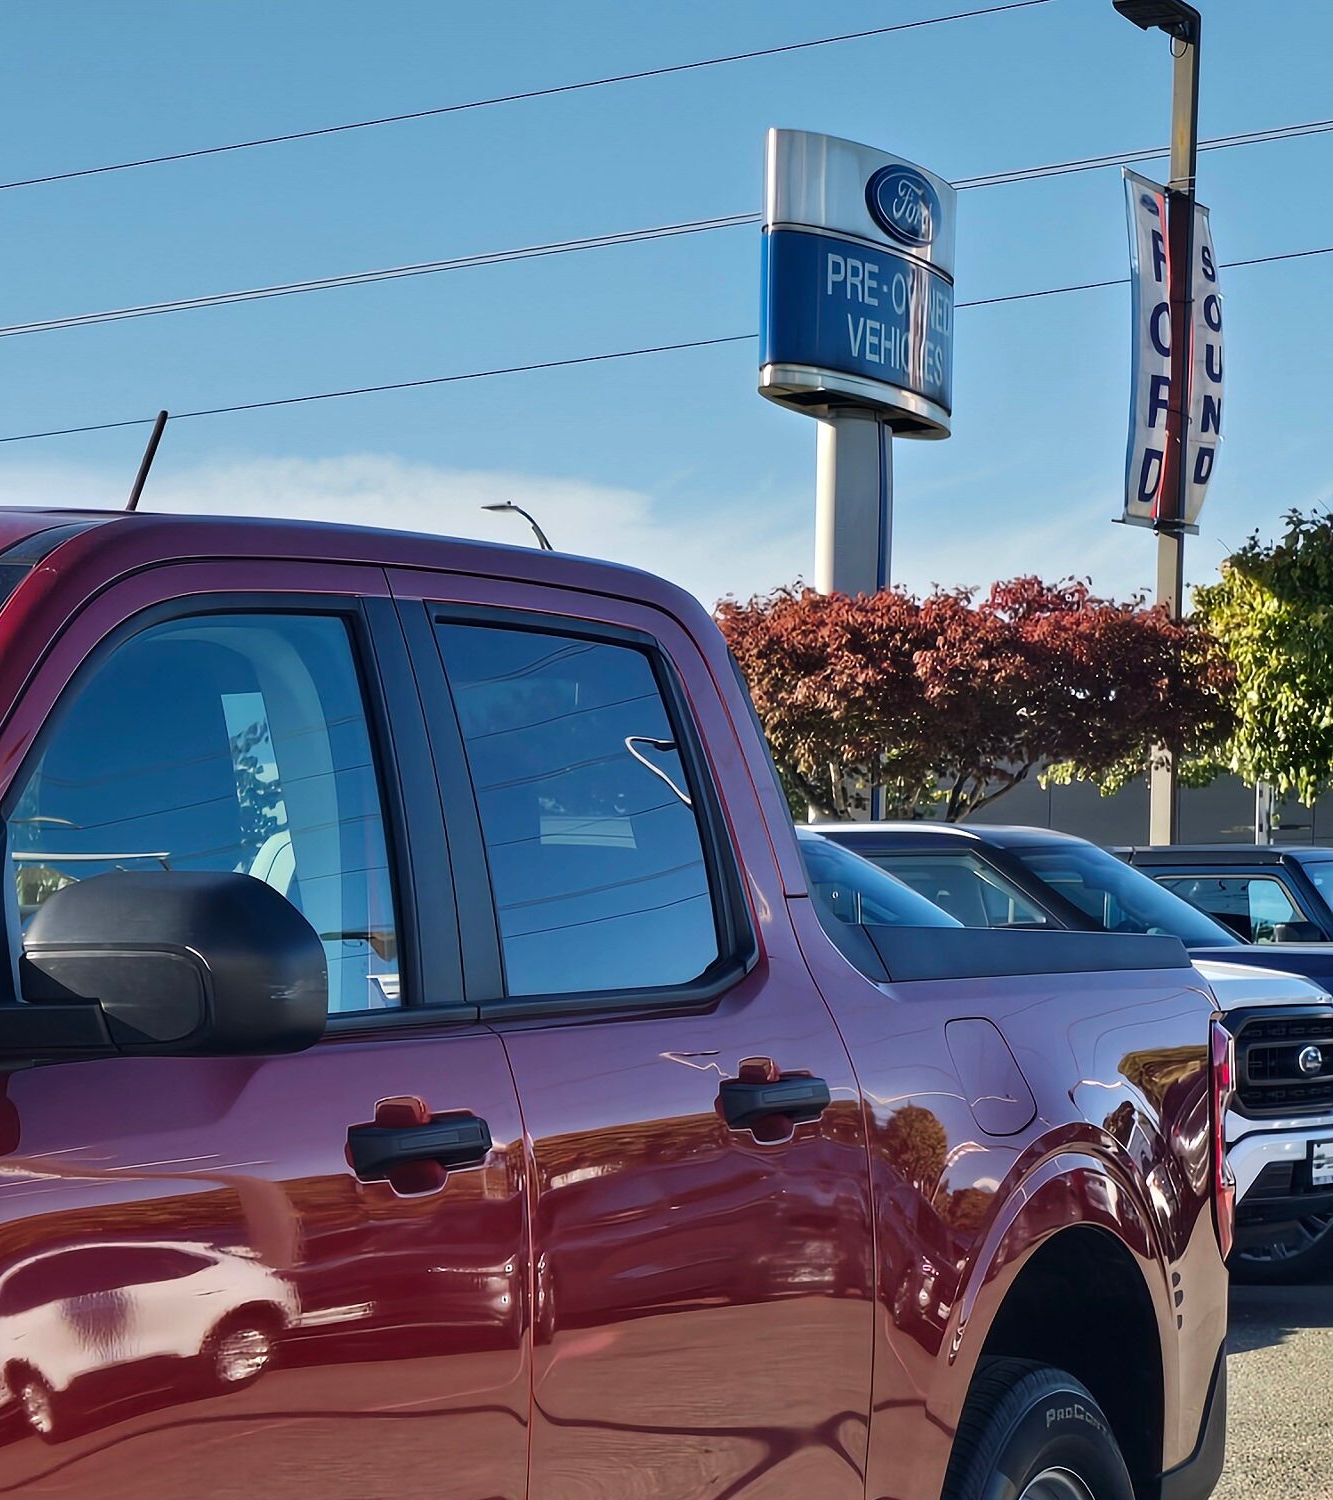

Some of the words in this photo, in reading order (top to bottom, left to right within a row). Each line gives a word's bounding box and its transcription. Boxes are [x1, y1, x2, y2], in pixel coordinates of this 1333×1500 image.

[892, 179, 933, 237] Ford
[847, 313, 942, 386] VEHICES
[1193, 246, 1223, 485] SOUND
